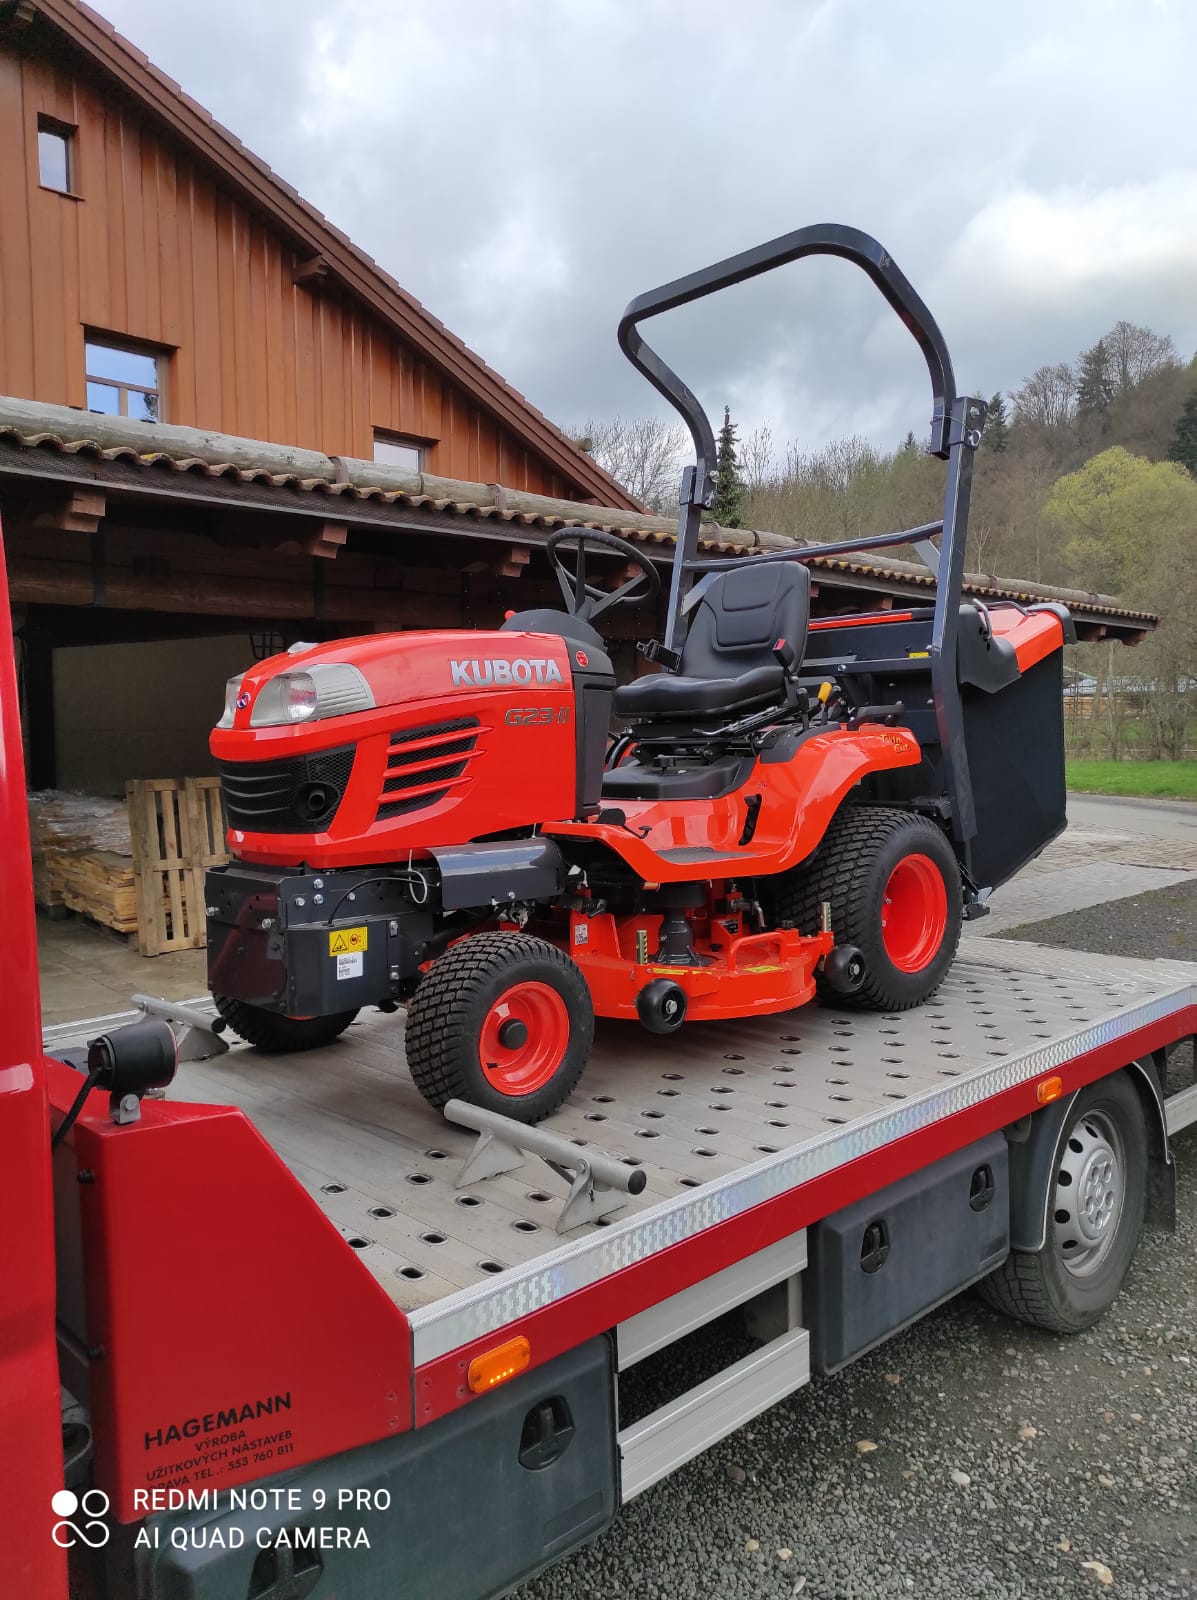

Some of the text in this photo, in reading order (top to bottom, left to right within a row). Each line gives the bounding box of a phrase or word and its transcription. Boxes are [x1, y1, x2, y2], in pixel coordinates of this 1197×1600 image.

[450, 658, 563, 686] KUBOTA
[144, 1392, 291, 1450] HAGEMANN
[195, 1430, 246, 1452] VÝROBA
[146, 1449, 228, 1482] UŽITKOVÝCH
[228, 1457, 249, 1471] 553
[253, 1449, 273, 1463] 760
[277, 1443, 294, 1456] 811
